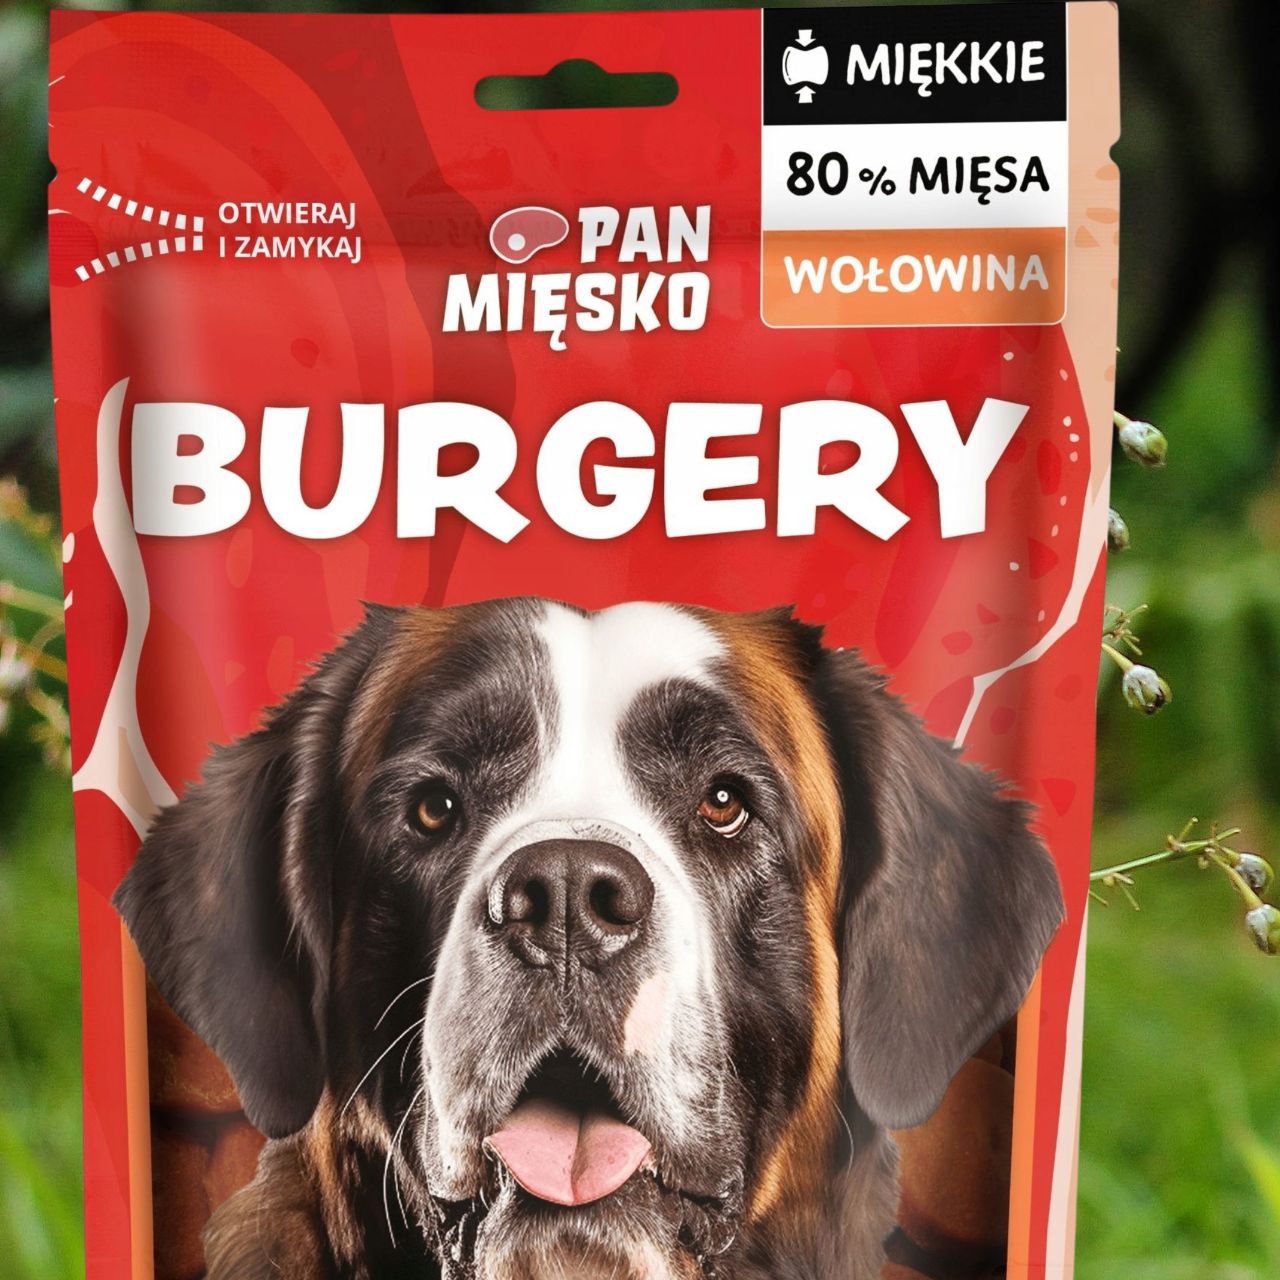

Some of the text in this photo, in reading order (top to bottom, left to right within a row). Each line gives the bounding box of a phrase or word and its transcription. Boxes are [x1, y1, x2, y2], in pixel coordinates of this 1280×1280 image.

[846, 41, 1045, 97] MIĘKKIE
[786, 151, 1050, 205] 80 % MIĘSA
[218, 201, 357, 229] OTWIERAJ
[578, 204, 711, 263] PAN
[219, 236, 362, 264] I ZAMYKAJ
[784, 254, 1049, 294] WOŁOWINA
[442, 271, 711, 351] MIĘSKO
[131, 398, 1030, 545] BURGERY
